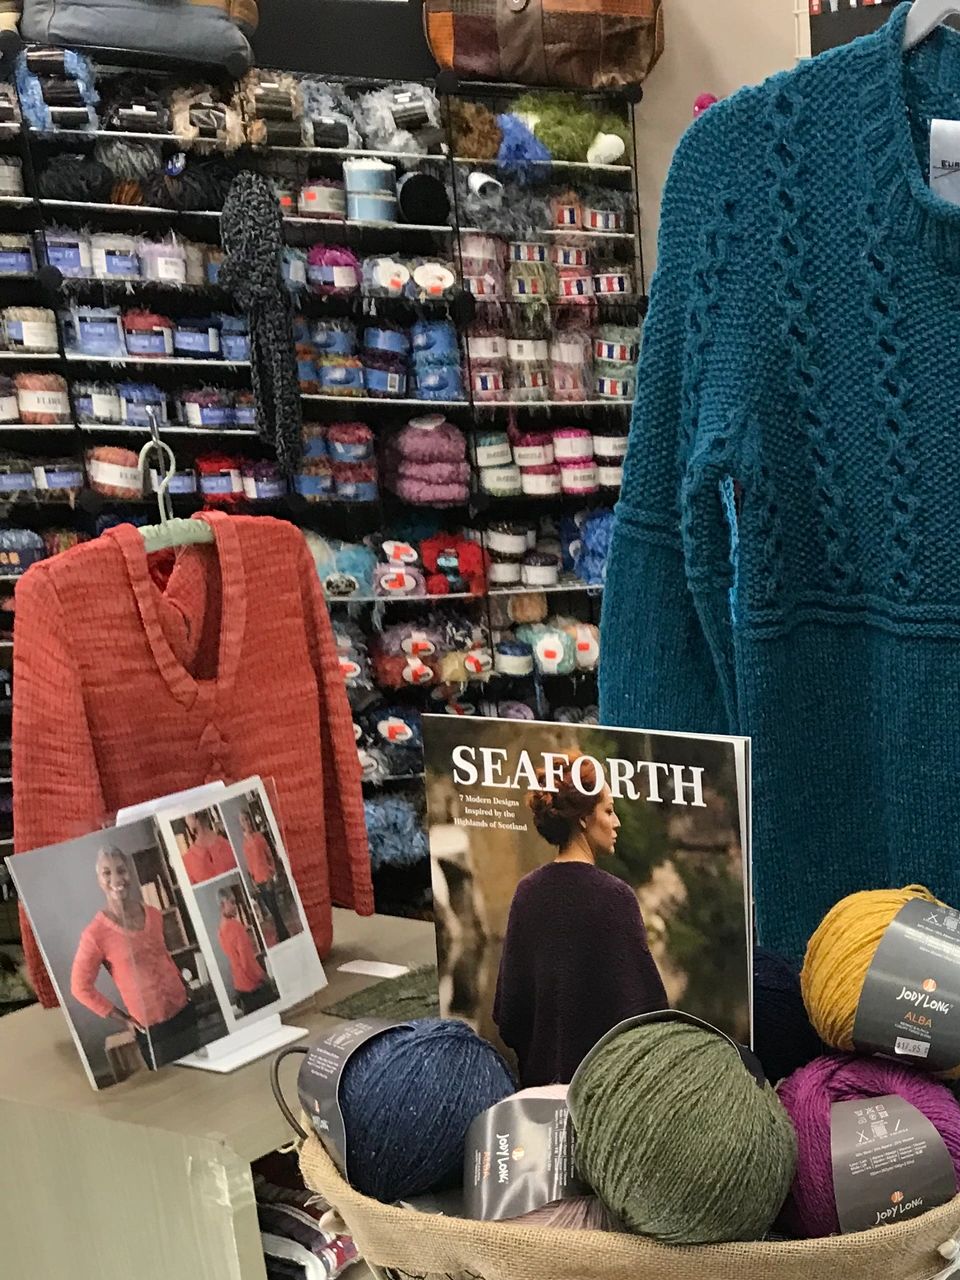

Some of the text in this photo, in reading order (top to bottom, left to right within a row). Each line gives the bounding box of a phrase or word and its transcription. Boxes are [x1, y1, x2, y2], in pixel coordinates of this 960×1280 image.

[452, 745, 707, 807] SEAFORTH
[466, 795, 492, 804] Modern
[494, 797, 519, 806] Designs
[464, 806, 516, 818] Inspired by the
[454, 818, 488, 827] Highlands
[499, 822, 528, 831] Scotland
[896, 986, 950, 1014] JODY LONG
[904, 1012, 932, 1028] ALBA
[496, 1134, 510, 1183] JODY LONG
[875, 1197, 923, 1224] JODY LONG
